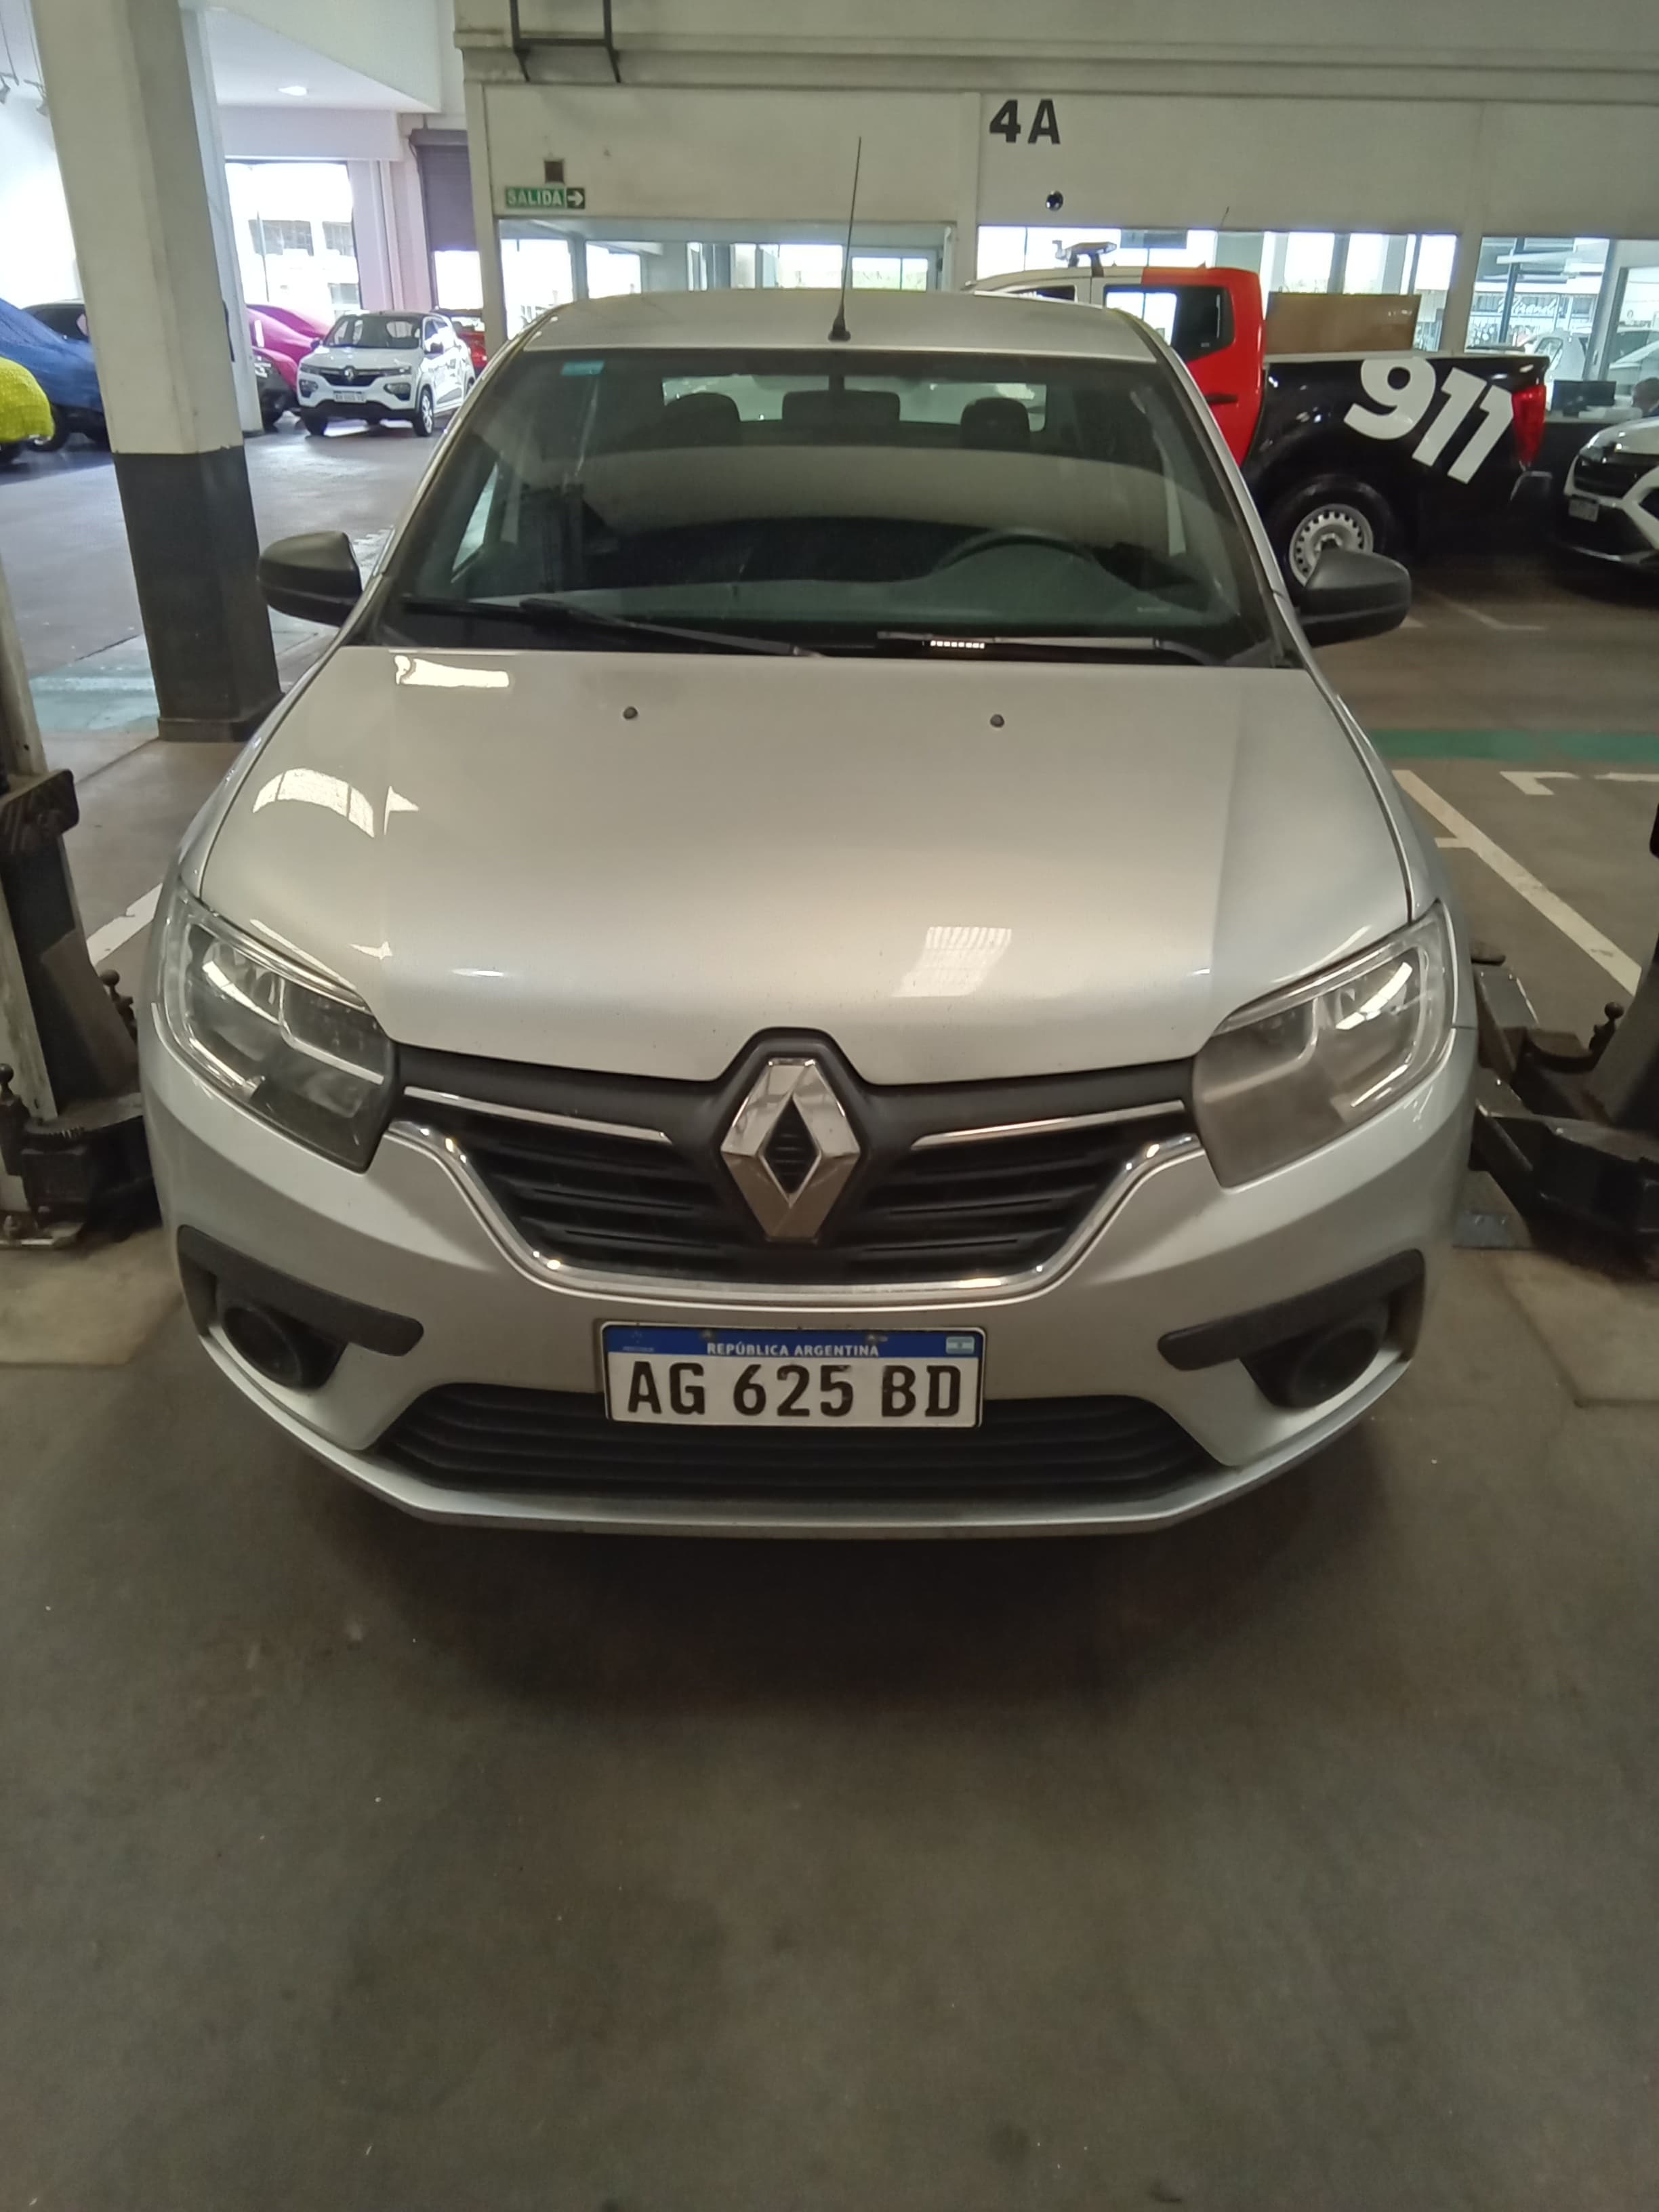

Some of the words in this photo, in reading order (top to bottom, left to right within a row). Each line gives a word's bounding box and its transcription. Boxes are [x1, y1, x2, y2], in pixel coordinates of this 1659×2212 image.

[989, 99, 1061, 144] 4A
[508, 189, 562, 206] SALIDA
[1344, 356, 1514, 484] 911
[708, 1342, 789, 1356] REPÚBLICA
[794, 1345, 879, 1357] ARGENTINA
[628, 1361, 705, 1415] AG
[733, 1364, 853, 1417] 625
[882, 1365, 961, 1417] BD
